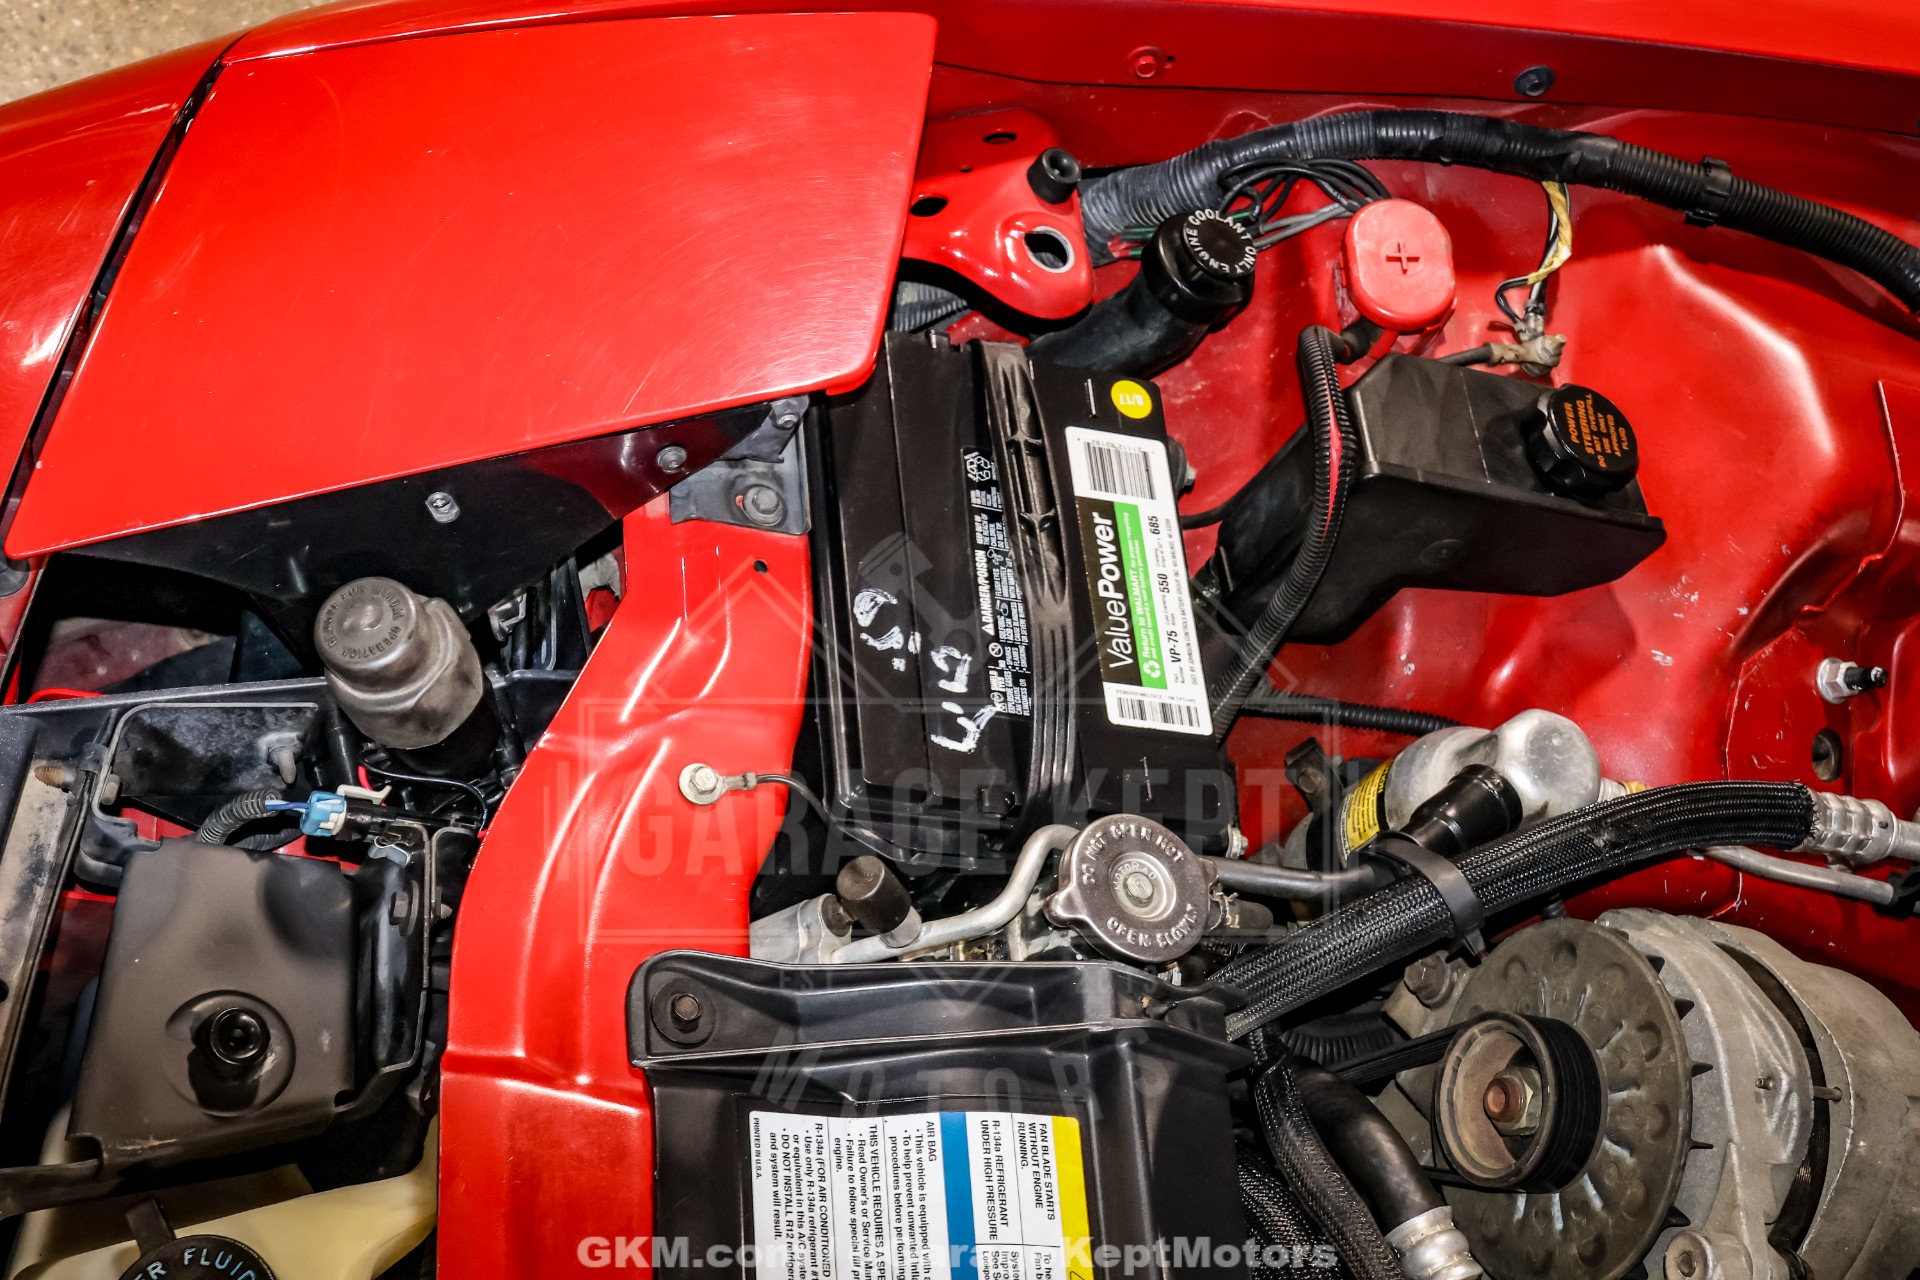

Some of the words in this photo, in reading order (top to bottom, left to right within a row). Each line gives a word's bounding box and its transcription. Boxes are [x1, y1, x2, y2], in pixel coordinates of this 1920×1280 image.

[1188, 208, 1250, 240] COOLANT
[1187, 229, 1230, 274] ENGINE
[1234, 246, 1257, 274] ONLY
[1564, 402, 1580, 443] POWER
[1586, 394, 1598, 431] OVERFILL
[1597, 412, 1607, 433] ONLY
[1576, 400, 1595, 454] STEERING
[1606, 414, 1622, 456] APPROVED
[1618, 427, 1629, 450] FLUID
[1592, 435, 1602, 452] NOT
[1602, 438, 1612, 453] USE
[1597, 455, 1606, 468] DO
[1123, 512, 1132, 538] recycling
[1148, 516, 1160, 535] 685
[1128, 540, 1136, 558] proper
[1134, 540, 1143, 566] purchase
[975, 550, 993, 623] DANGER/POISON
[1092, 512, 1134, 668] ValuePower
[1130, 569, 1143, 615] WALMART
[1138, 568, 1146, 588] battery
[1157, 573, 1170, 593] 550
[1139, 617, 1145, 626] to
[1141, 628, 1150, 658] Return
[1166, 630, 1182, 663] VP-75
[1006, 688, 1015, 713] EXPLOSIVE
[1014, 686, 1022, 703] CAUSE
[1021, 688, 1030, 716] BLINDNESS
[1086, 832, 1106, 860] NOT
[1110, 824, 1152, 840] OPEN
[1155, 834, 1185, 862] HOT
[1082, 863, 1096, 885] DO
[1106, 916, 1151, 947] OPEN
[1156, 903, 1198, 948] SLOWLY
[753, 1118, 761, 1148] PRINTED
[770, 1132, 778, 1150] and
[781, 1134, 790, 1149] DO
[792, 1134, 799, 1144] or
[815, 1123, 825, 1155] R-134a
[869, 1124, 878, 1147] THIS
[902, 1135, 912, 1146] To
[926, 1121, 935, 1138] AIR
[980, 1120, 991, 1155] UNDER
[992, 1120, 1002, 1152] R-134a
[1039, 1123, 1048, 1142] FAN
[804, 1136, 813, 1154] Use
[833, 1138, 844, 1173] engine.
[846, 1140, 855, 1172] Failure
[858, 1140, 867, 1164] Read
[915, 1134, 924, 1154] This
[928, 1141, 937, 1162] BAG
[1017, 1122, 1028, 1170] RUNNING.
[1028, 1123, 1039, 1168] WITHOUT
[769, 1153, 780, 1187] system
[782, 1152, 791, 1173] NOT
[792, 1147, 804, 1196] equivalent
[804, 1157, 814, 1177] only
[815, 1158, 826, 1182] (FOR
[871, 1149, 882, 1192] VEHICLE
[888, 1136, 900, 1190] procedures
[901, 1149, 913, 1169] help
[984, 1158, 993, 1182] HIGH
[1041, 1145, 1051, 1179] BLADE
[848, 1174, 856, 1183] to
[859, 1167, 869, 1205] Owner's
[916, 1157, 927, 1190] vehicle
[772, 1190, 781, 1206] will
[783, 1176, 793, 1217] INSTALL
[796, 1199, 804, 1208] in
[806, 1180, 816, 1212] R-134a
[818, 1185, 827, 1202] AIR
[848, 1186, 858, 1215] follow
[903, 1172, 916, 1208] prevent
[918, 1194, 927, 1202] is
[995, 1155, 1008, 1227] REFRIGERANT
[1032, 1171, 1043, 1208] ENGINE
[1045, 1182, 1055, 1220] STARTS
[797, 1211, 806, 1229] this
[862, 1208, 869, 1218] or
[873, 1195, 884, 1248] REQUIRES
[894, 1193, 903, 1224] before
[986, 1185, 997, 1240] PRESSURE
[773, 1210, 782, 1240] result.
[785, 1220, 794, 1238] R12
[848, 1218, 860, 1252] special
[908, 1211, 919, 1259] unwanted
[915, 1204, 930, 1250] equipped
[798, 1232, 807, 1249] A/C
[807, 1215, 818, 1268] refrigerant
[819, 1205, 831, 1277] CONDITIONED
[862, 1221, 872, 1258] Service
[890, 1226, 907, 1280] performing
[797, 1253, 807, 1280] syste
[852, 1256, 861, 1267] fill
[922, 1253, 932, 1274] with
[982, 1251, 991, 1280] Lockpo
[992, 1251, 1001, 1269] See
[1000, 1251, 1010, 1280] Impro
[1010, 1251, 1020, 1280] Syste
[1034, 1253, 1042, 1270] Fan
[1043, 1253, 1052, 1264] To
